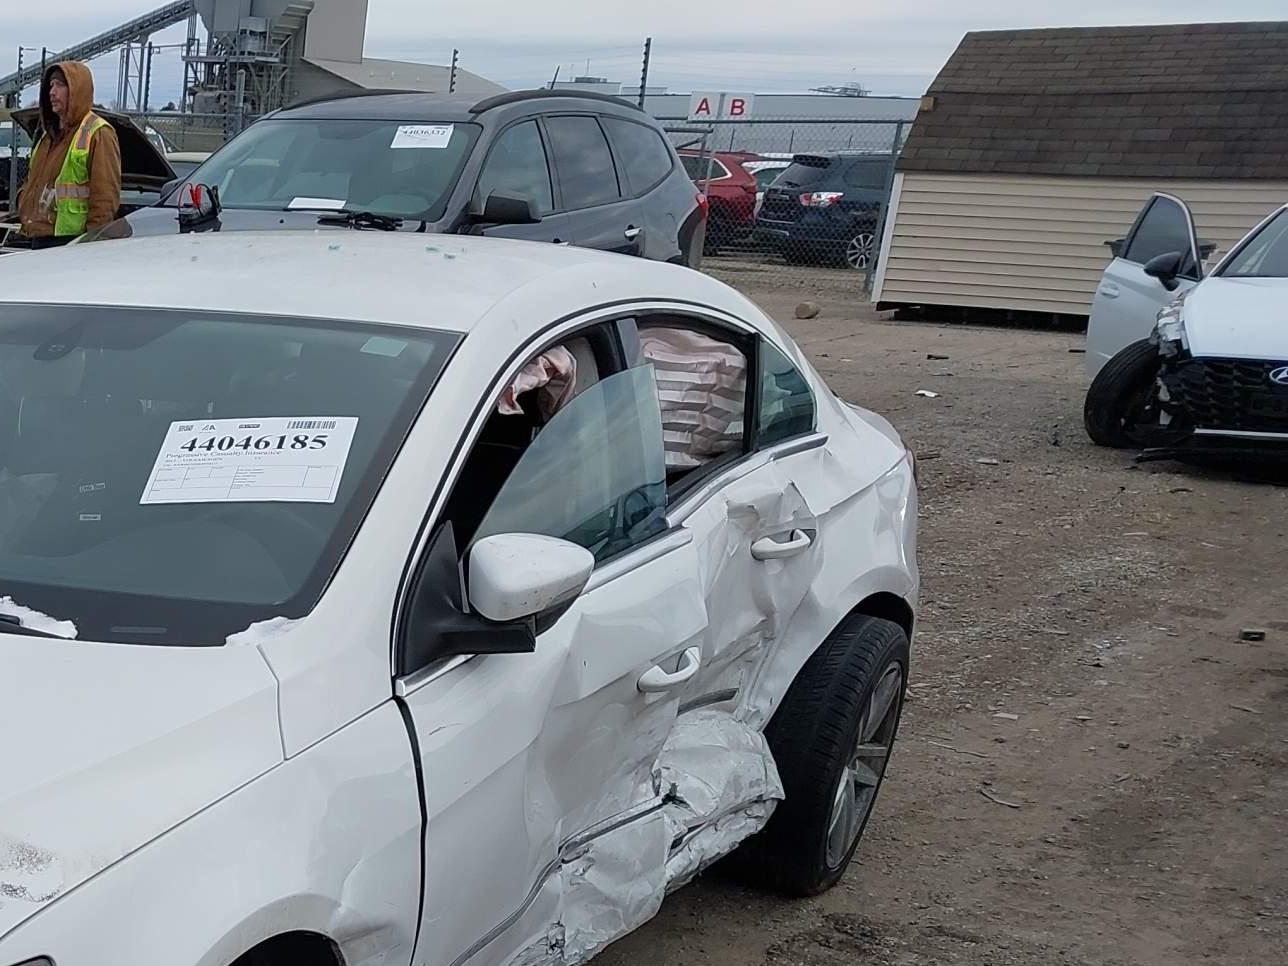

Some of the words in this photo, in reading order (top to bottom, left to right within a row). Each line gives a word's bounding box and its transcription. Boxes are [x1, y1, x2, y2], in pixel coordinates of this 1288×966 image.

[695, 98, 711, 115] A
[730, 99, 746, 116] B
[180, 434, 329, 452] 44046185
